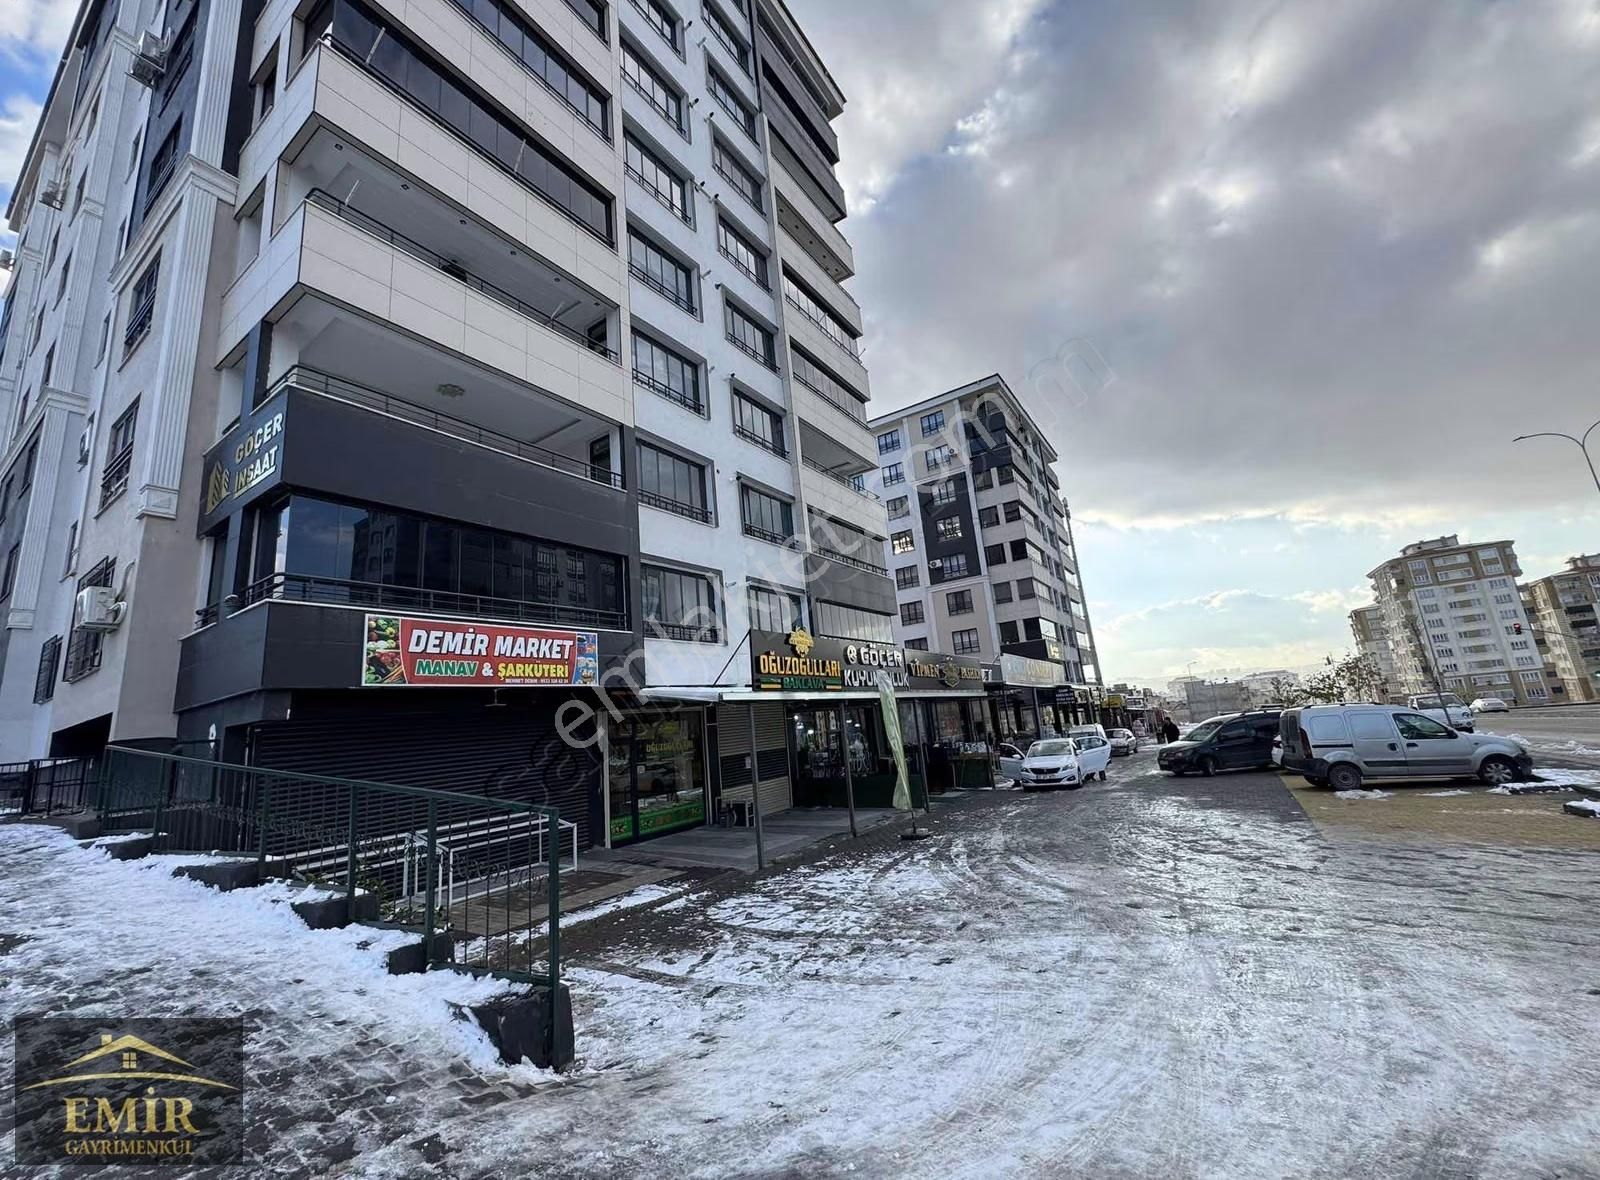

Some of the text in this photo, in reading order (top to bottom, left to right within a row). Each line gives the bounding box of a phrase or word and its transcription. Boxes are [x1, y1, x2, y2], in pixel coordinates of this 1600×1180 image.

[235, 412, 284, 464] GÖÇER
[408, 628, 574, 661] DEMİR MARKET
[860, 643, 902, 668] GÖÇER
[415, 659, 569, 681] MANAV & ŞARKÜTERİ
[759, 651, 841, 677] OĞUZOĞULLARI
[783, 677, 824, 689] BAKLAVA
[844, 669, 910, 690] KUYULUK
